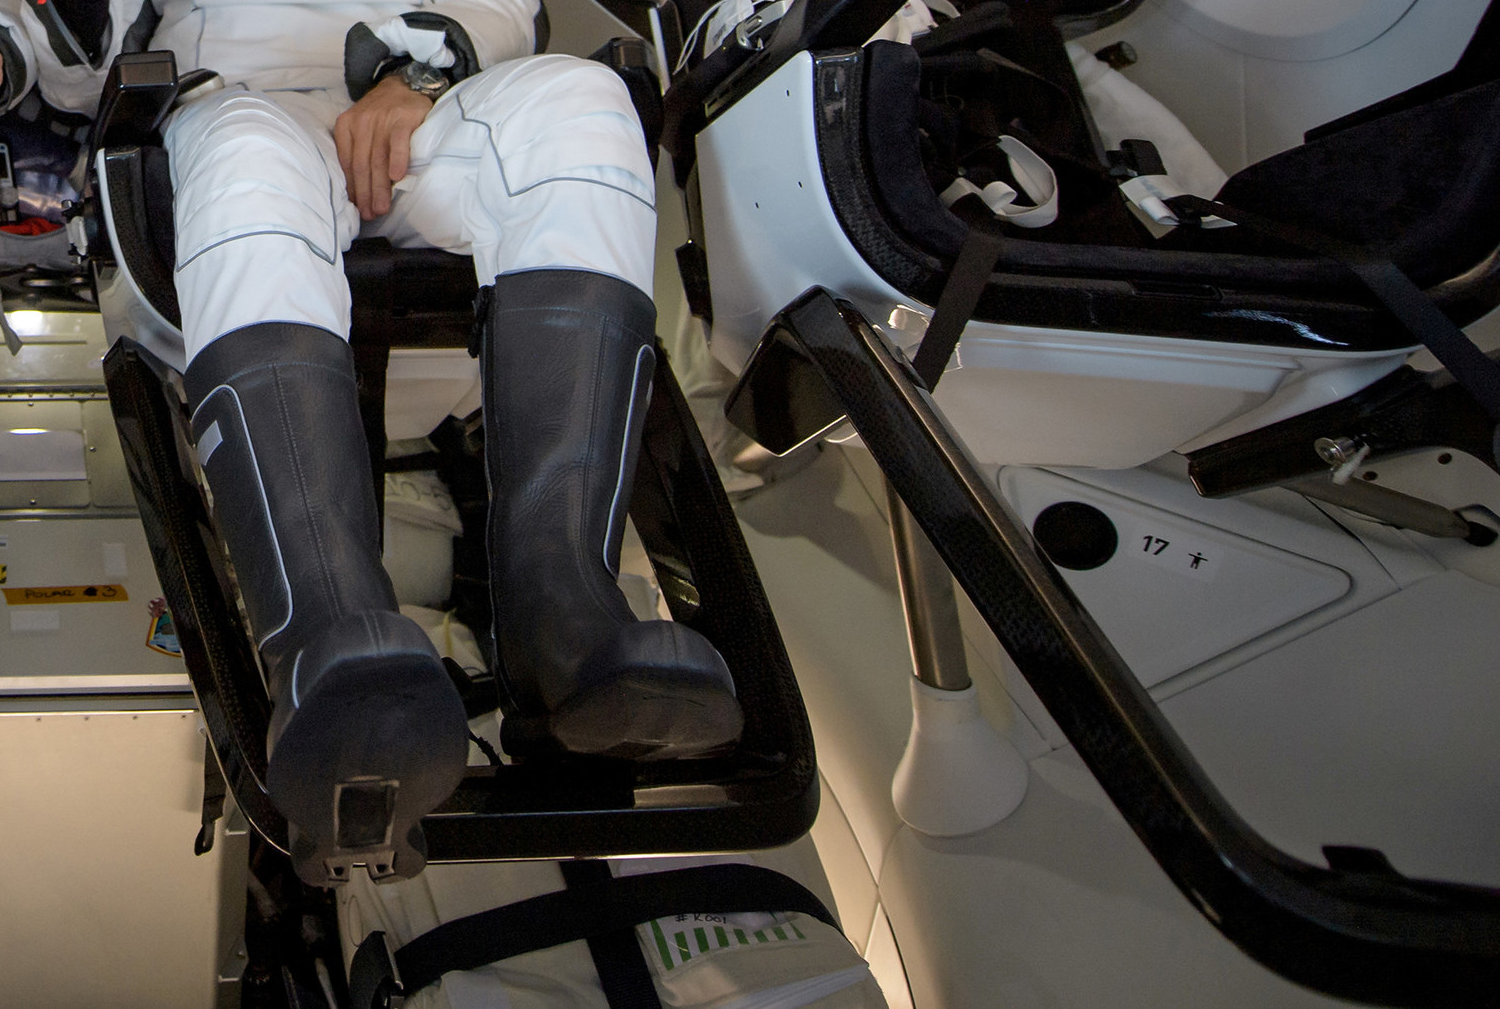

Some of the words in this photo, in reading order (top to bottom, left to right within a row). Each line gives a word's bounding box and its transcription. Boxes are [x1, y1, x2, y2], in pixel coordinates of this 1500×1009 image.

[1142, 535, 1170, 555] 17
[24, 589, 76, 599] POLAR
[101, 585, 117, 597] 3
